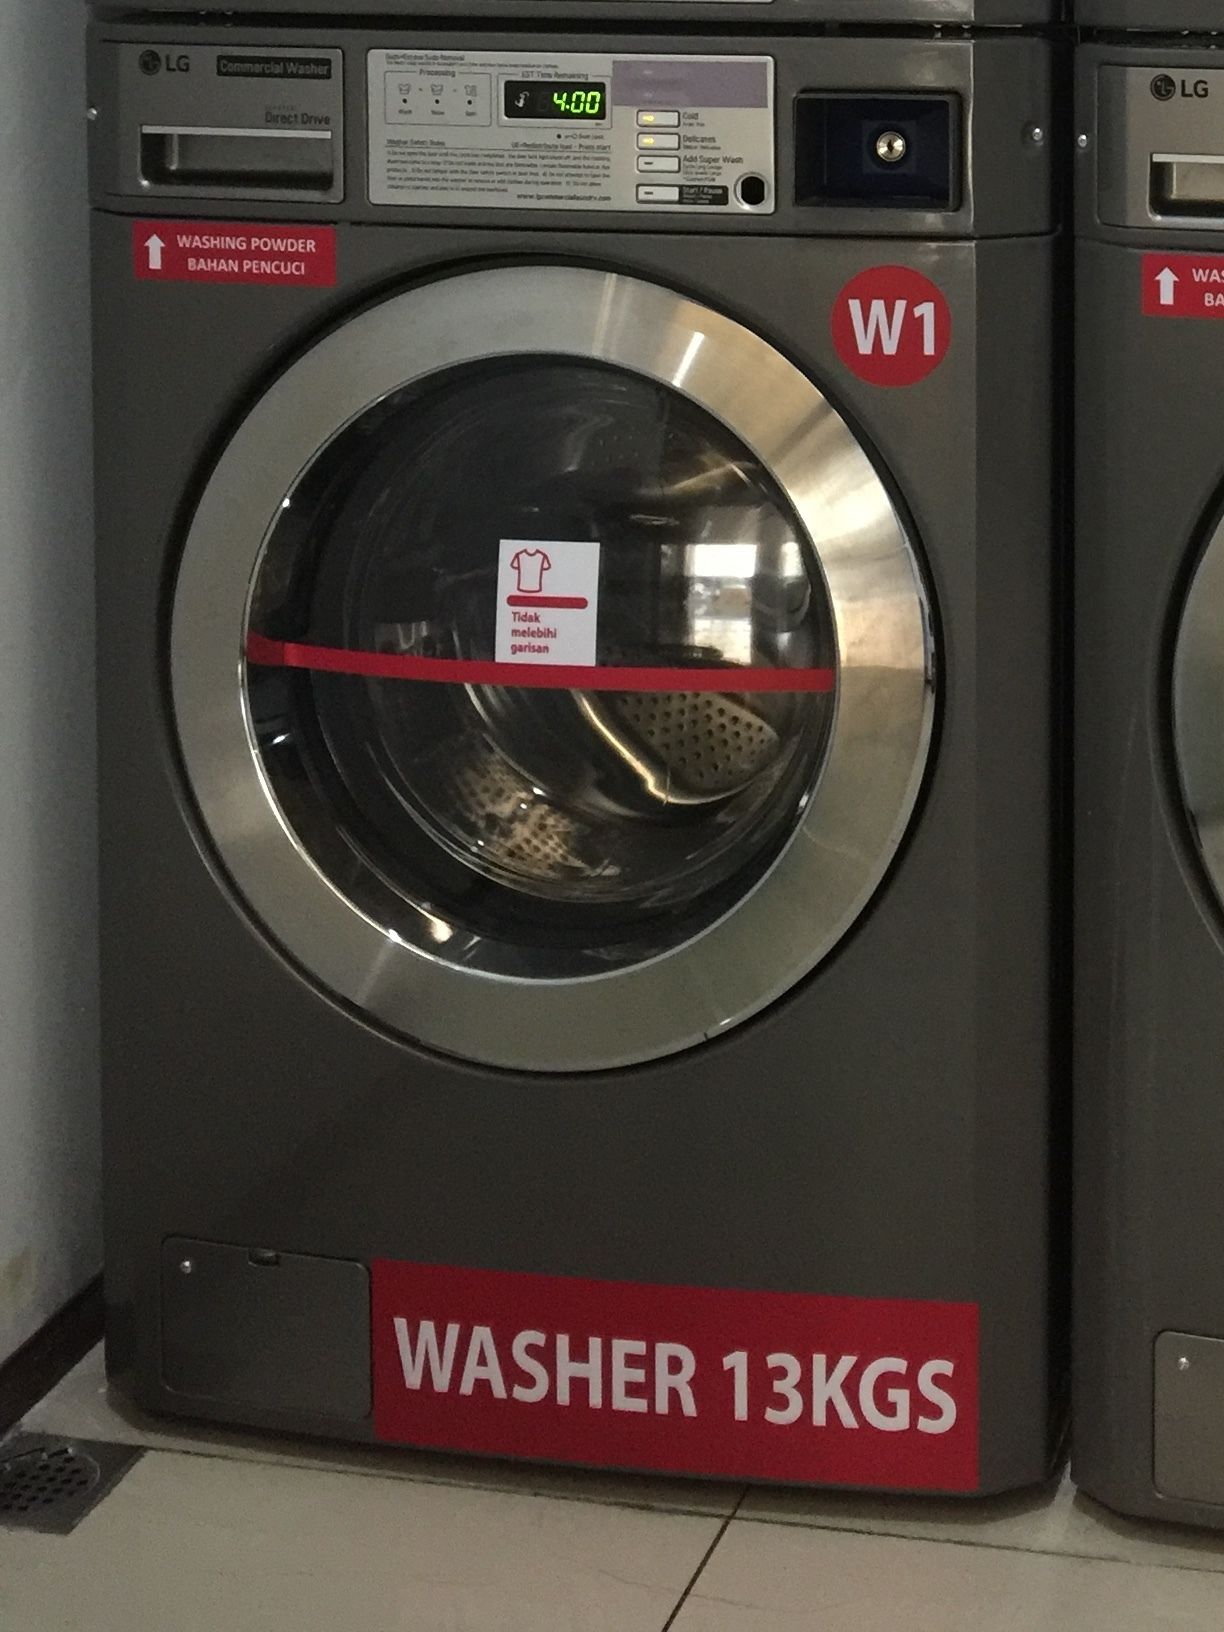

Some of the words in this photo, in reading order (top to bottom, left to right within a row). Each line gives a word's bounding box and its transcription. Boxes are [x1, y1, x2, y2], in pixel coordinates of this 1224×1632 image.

[166, 55, 190, 73] LG
[221, 59, 283, 74] Commercial
[286, 61, 329, 75] Washer
[1181, 79, 1209, 97] LG
[553, 91, 601, 113] 4.00
[265, 111, 298, 125] Direct
[301, 113, 330, 125] Drive
[177, 235, 247, 250] WASHING
[251, 237, 316, 253] POWDER
[187, 257, 239, 272] BAHAN
[243, 260, 305, 275] PENCUCI
[848, 299, 934, 355] W1
[512, 611, 541, 623] Tidak
[511, 626, 557, 639] melebihi
[510, 643, 549, 655] garisan
[393, 1317, 697, 1418] WASHER
[721, 1350, 958, 1435] 13KGS
